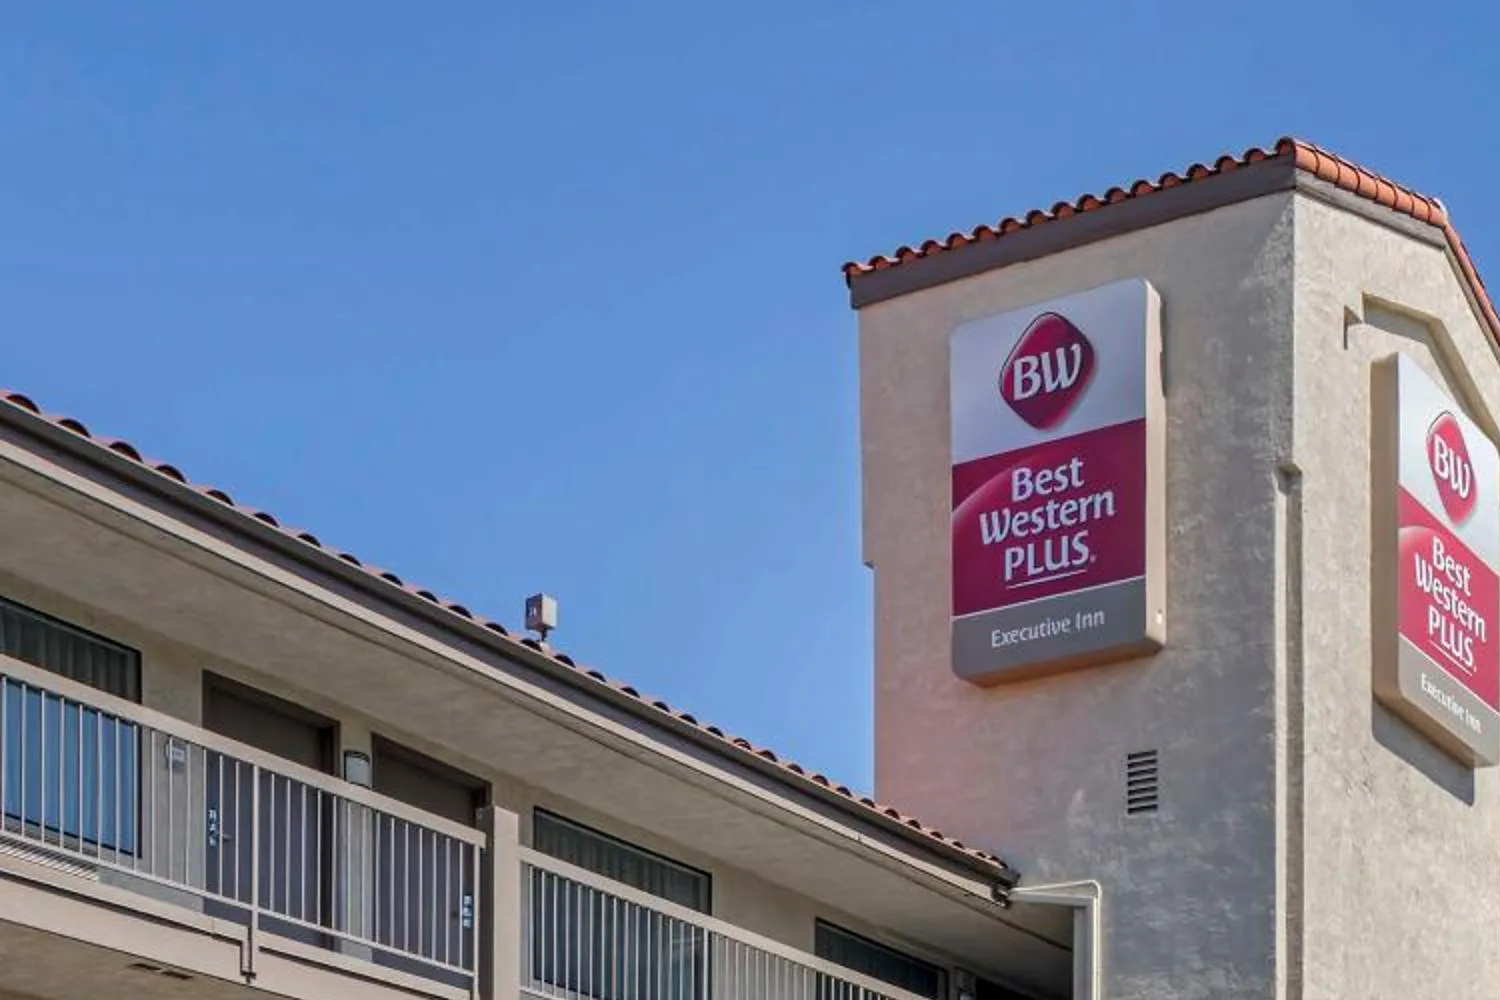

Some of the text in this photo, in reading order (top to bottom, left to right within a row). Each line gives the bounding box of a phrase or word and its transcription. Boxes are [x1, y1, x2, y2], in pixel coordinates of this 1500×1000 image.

[1012, 343, 1082, 402] BW
[1011, 456, 1085, 502] Best
[1433, 434, 1471, 499] BW
[979, 488, 1116, 546] Western
[1431, 535, 1472, 598] Best
[1415, 552, 1487, 643] Western
[991, 609, 1106, 648] Executive Inn
[1420, 672, 1482, 735] Executive Inn
